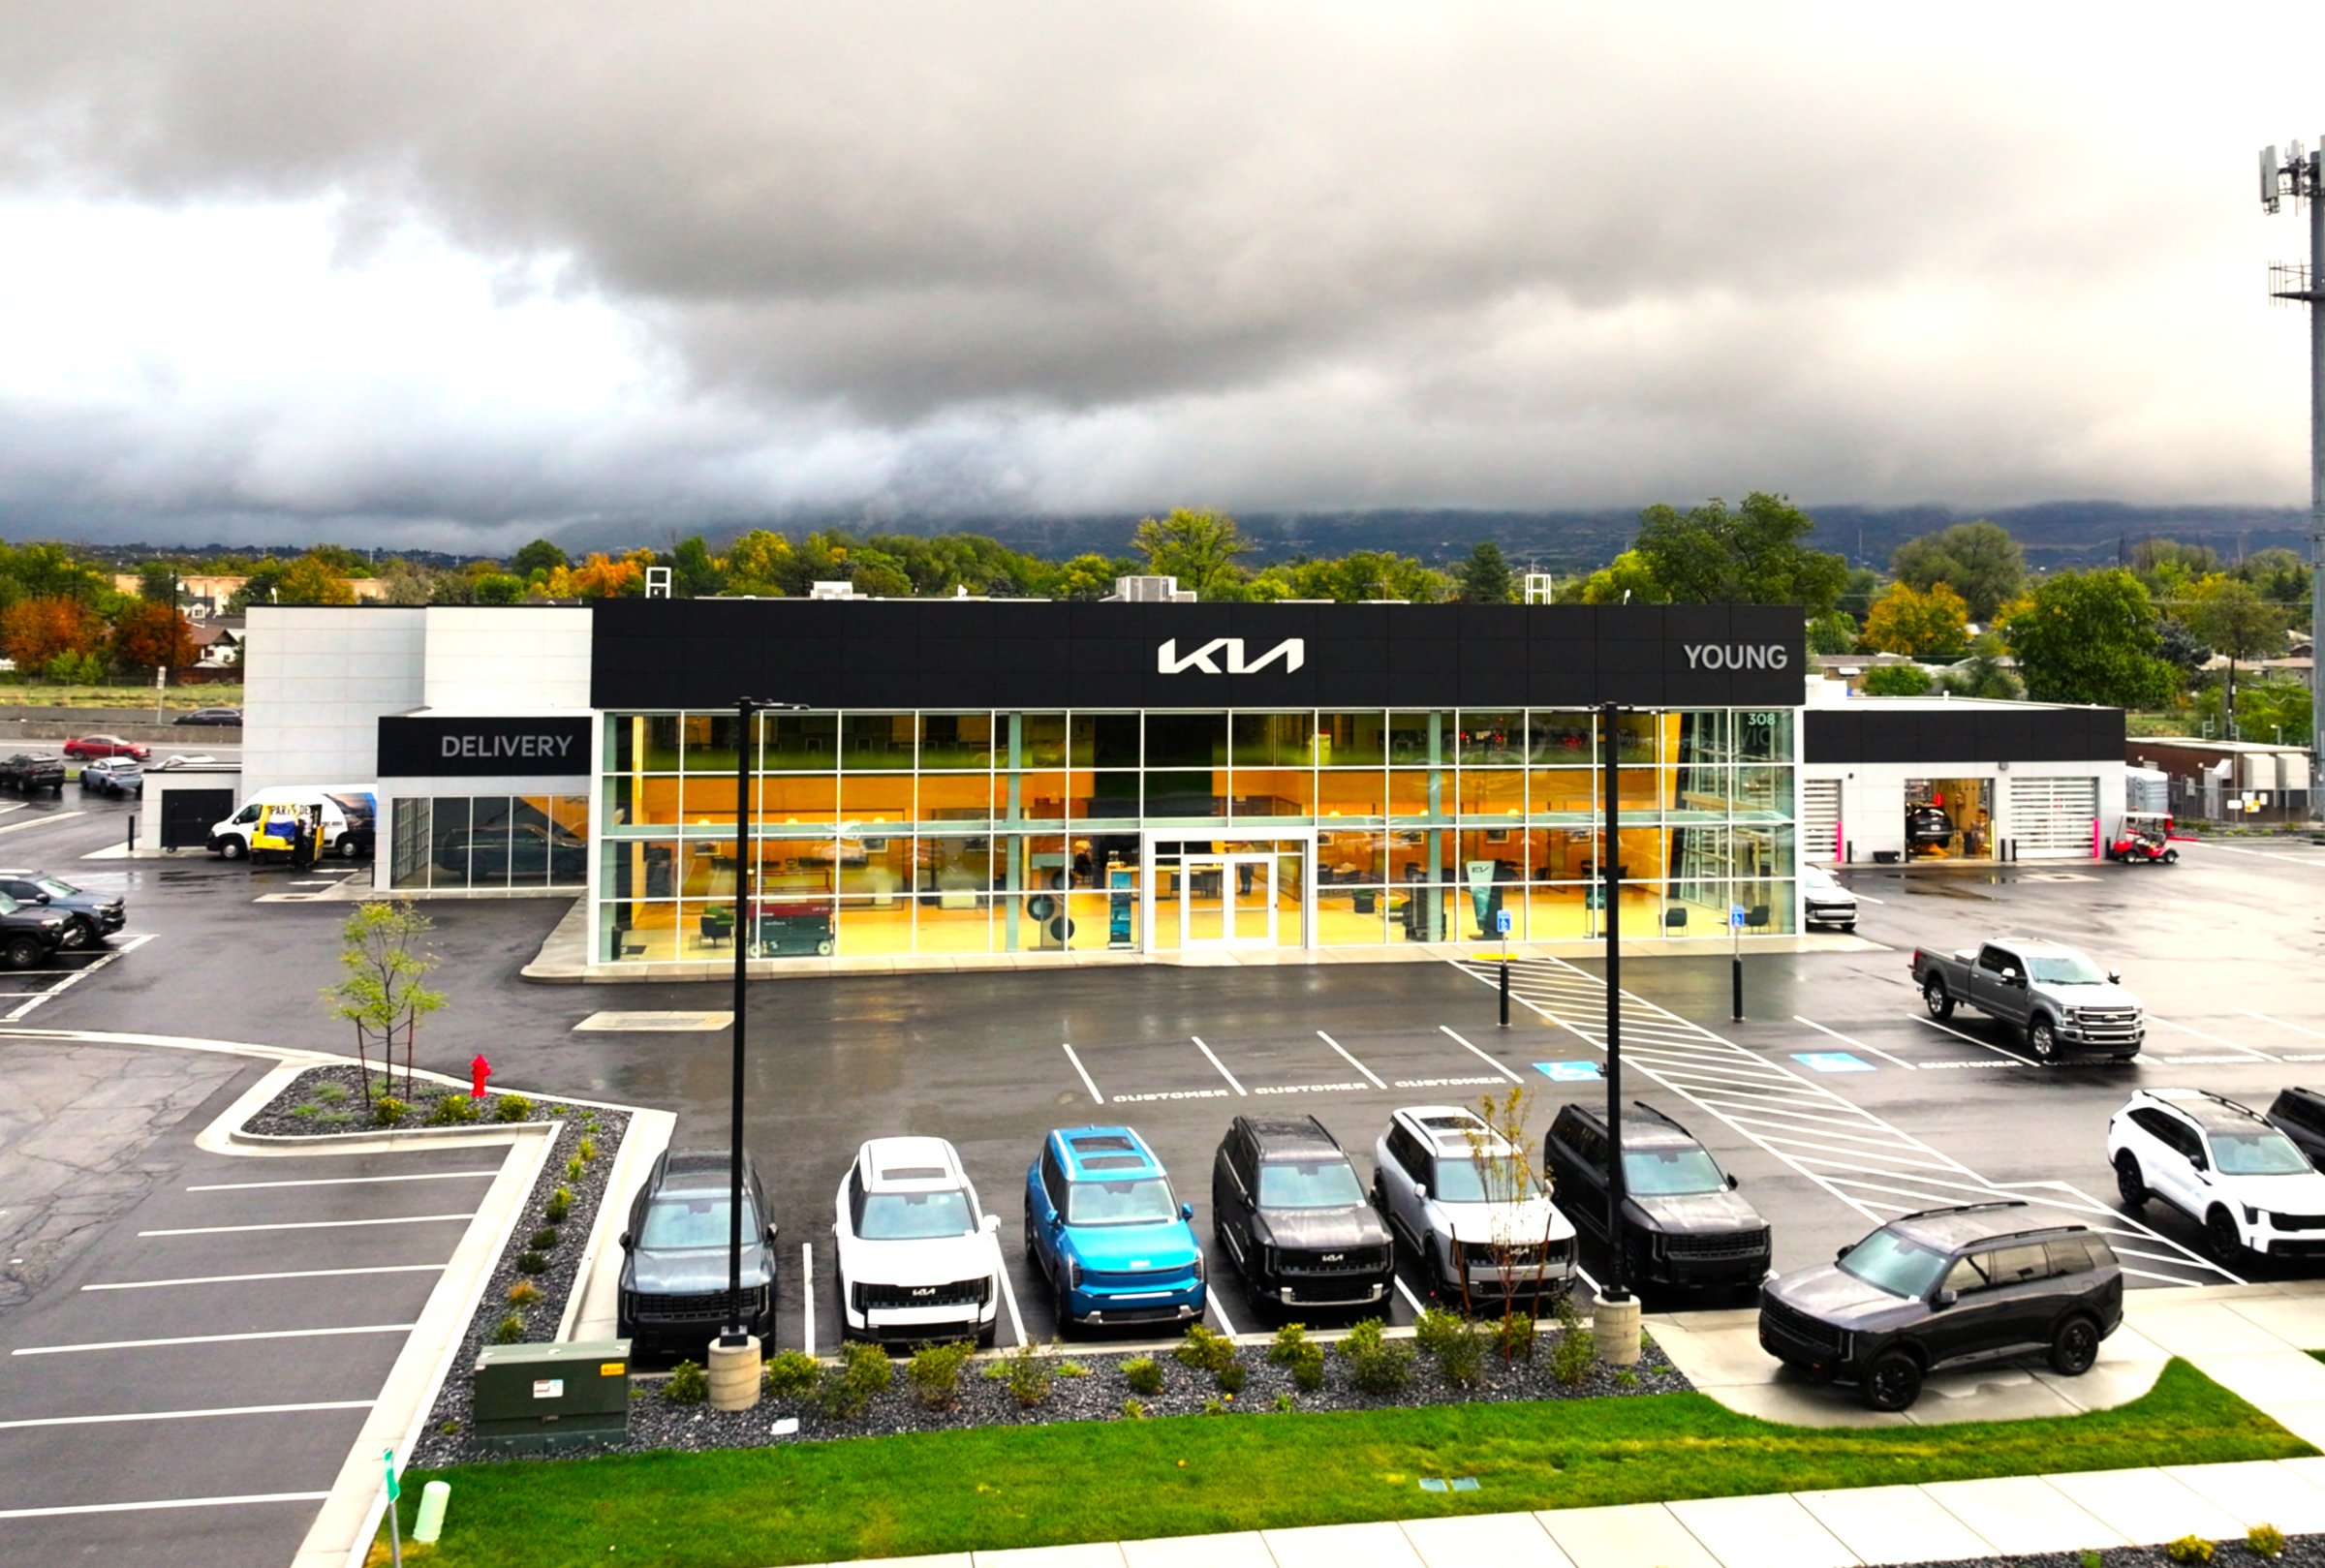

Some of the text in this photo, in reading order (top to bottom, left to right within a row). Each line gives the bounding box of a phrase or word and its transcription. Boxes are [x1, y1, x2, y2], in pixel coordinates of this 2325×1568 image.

[1158, 637, 1304, 674] KIA
[1683, 644, 1788, 670] YOUNG
[1748, 713, 1776, 725] 308
[441, 734, 573, 757] DELIVERY
[1112, 1089, 1229, 1102] CUSTOMER
[1255, 1082, 1369, 1094] CUSTOMER
